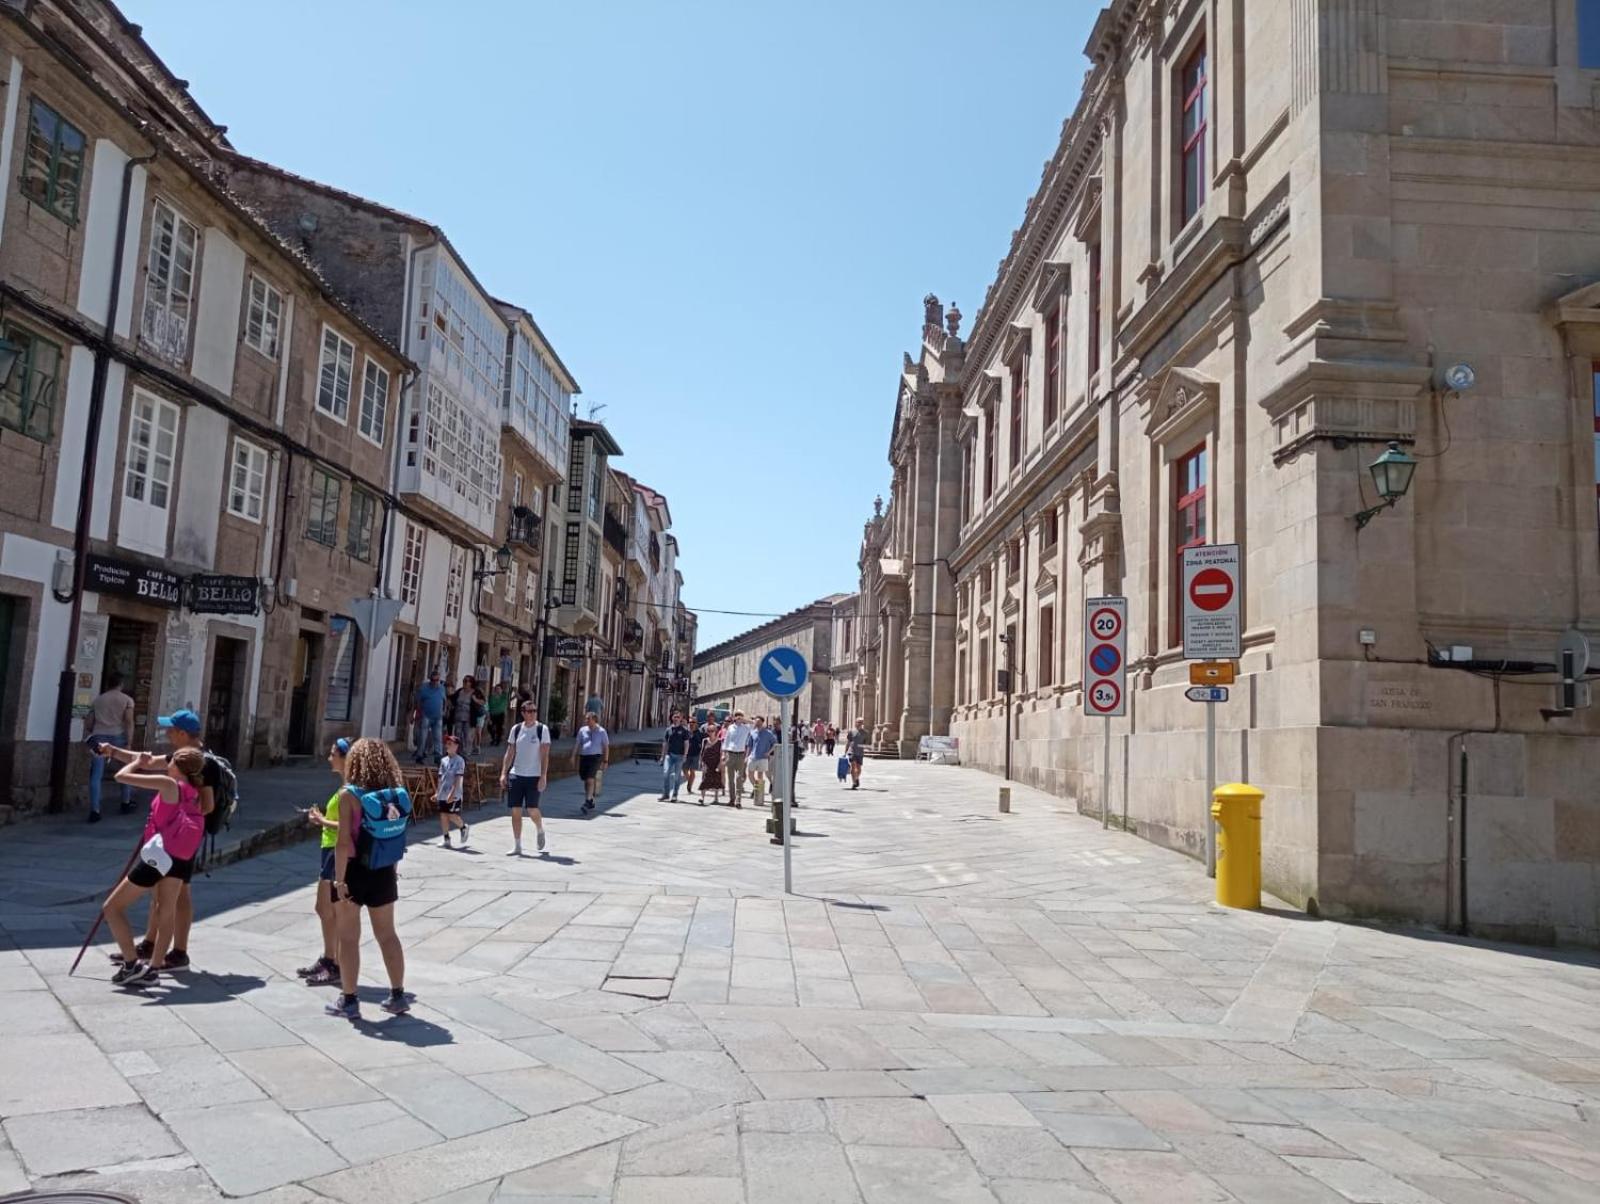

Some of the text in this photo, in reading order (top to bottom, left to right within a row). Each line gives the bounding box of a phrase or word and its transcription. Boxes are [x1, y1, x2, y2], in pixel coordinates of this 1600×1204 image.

[1205, 557, 1238, 565] PEATONAL
[93, 563, 131, 577] Productos
[137, 578, 178, 602] BELLO
[197, 586, 252, 603] BELLO
[1097, 619, 1115, 631] 20
